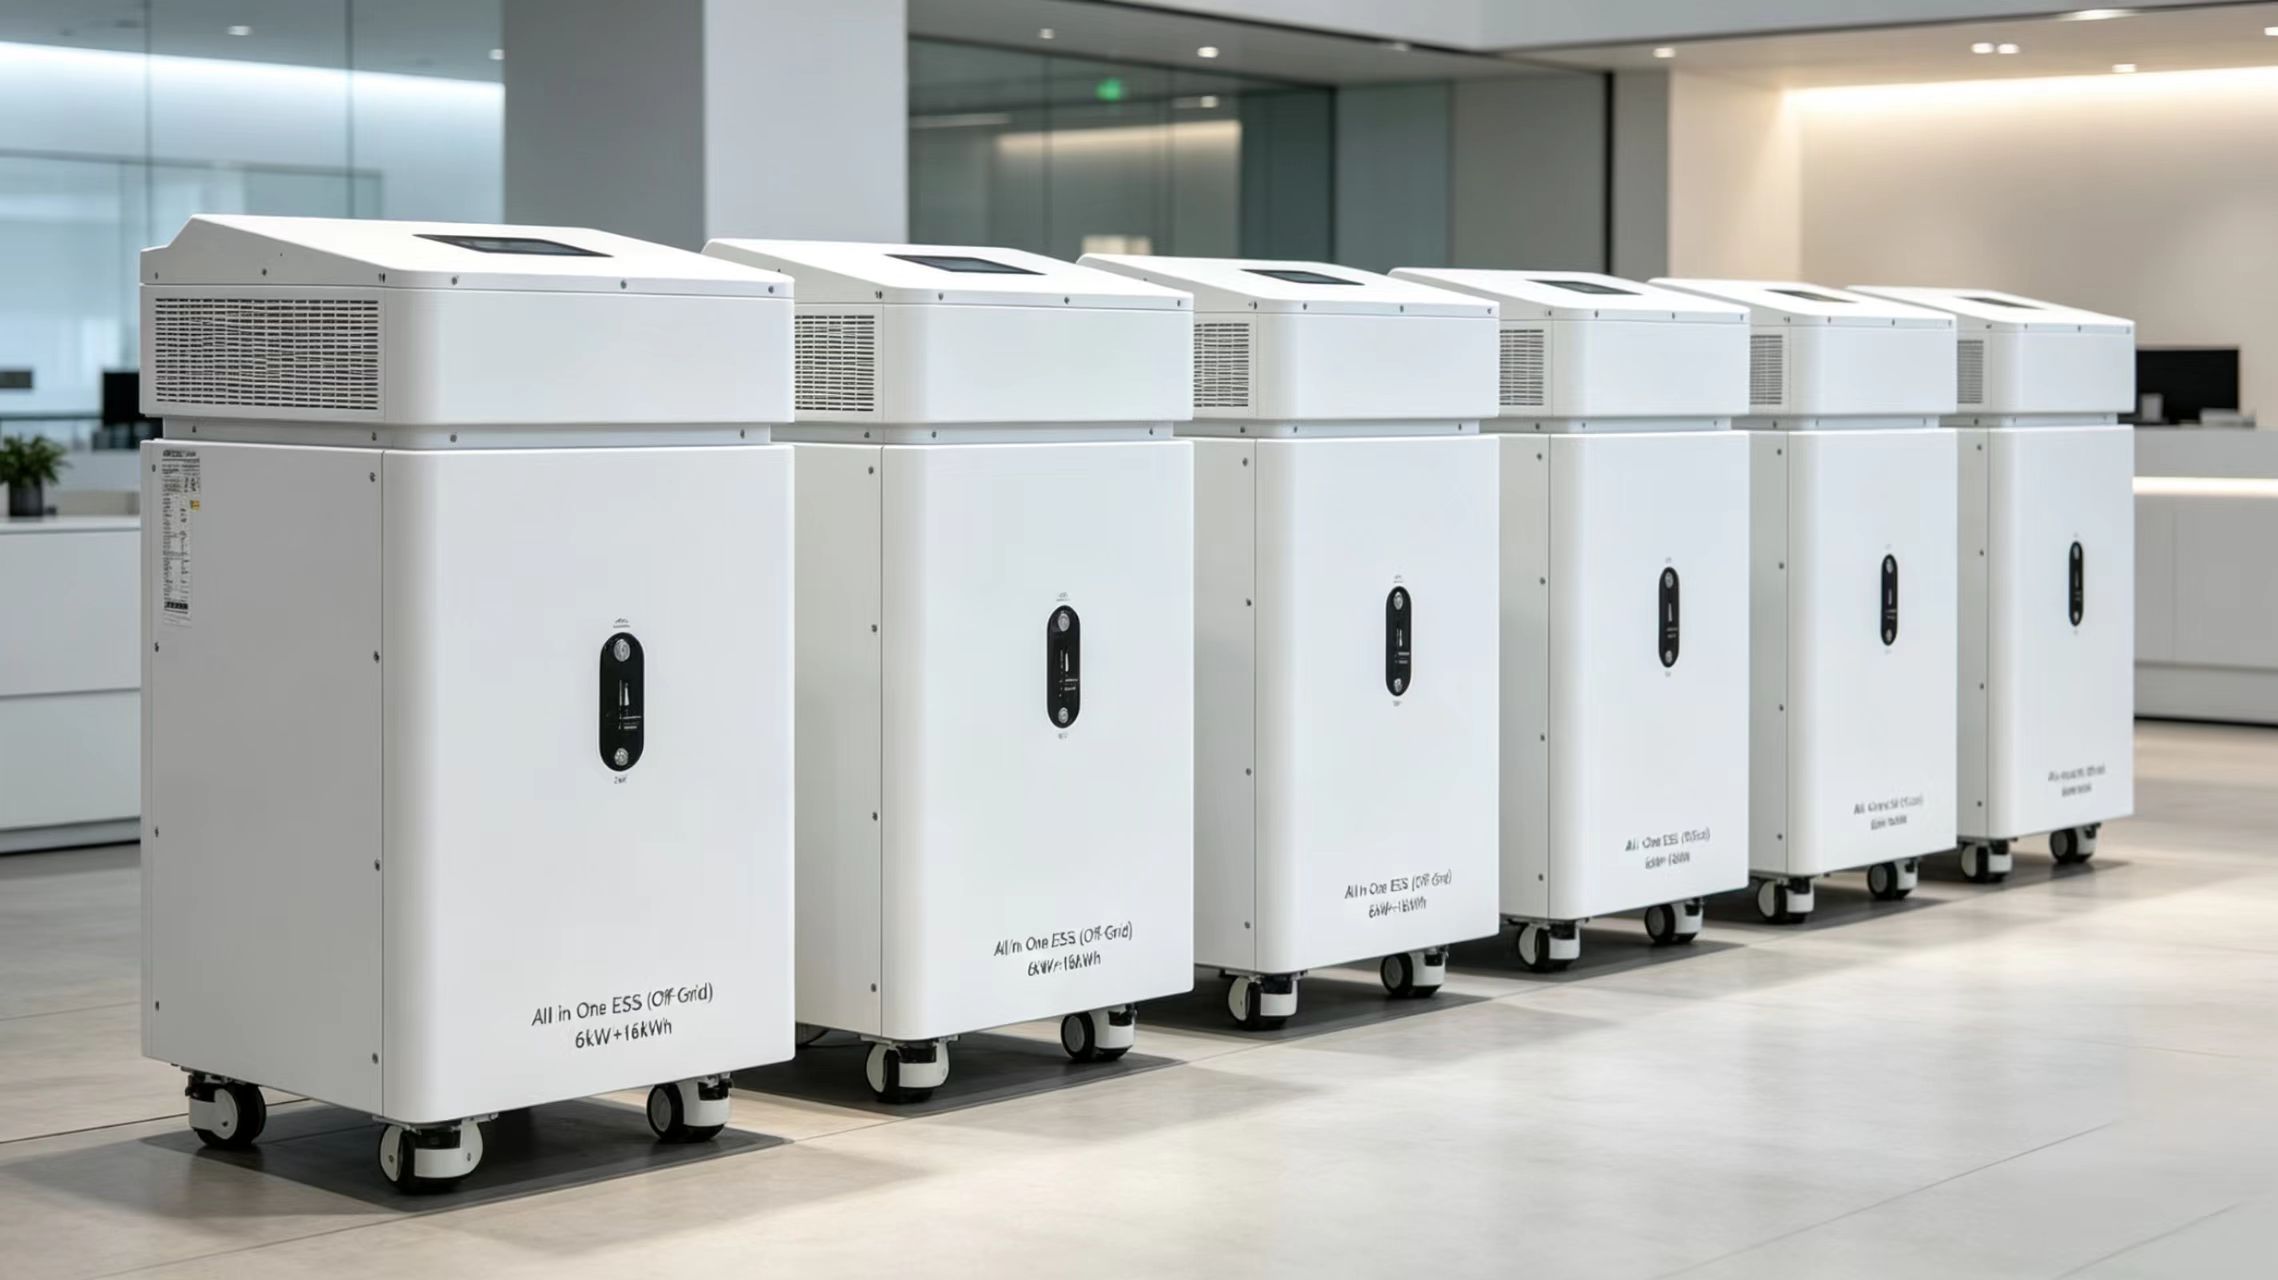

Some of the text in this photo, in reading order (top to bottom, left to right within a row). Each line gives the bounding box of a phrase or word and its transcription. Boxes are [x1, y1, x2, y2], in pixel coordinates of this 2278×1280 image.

[1025, 936, 1049, 952] One
[1051, 930, 1076, 949] ESS
[531, 1006, 553, 1027] All
[558, 1005, 571, 1022] in
[576, 1001, 607, 1020] One
[611, 993, 643, 1015] ESS
[574, 1016, 673, 1049] 6kW+16kWh
